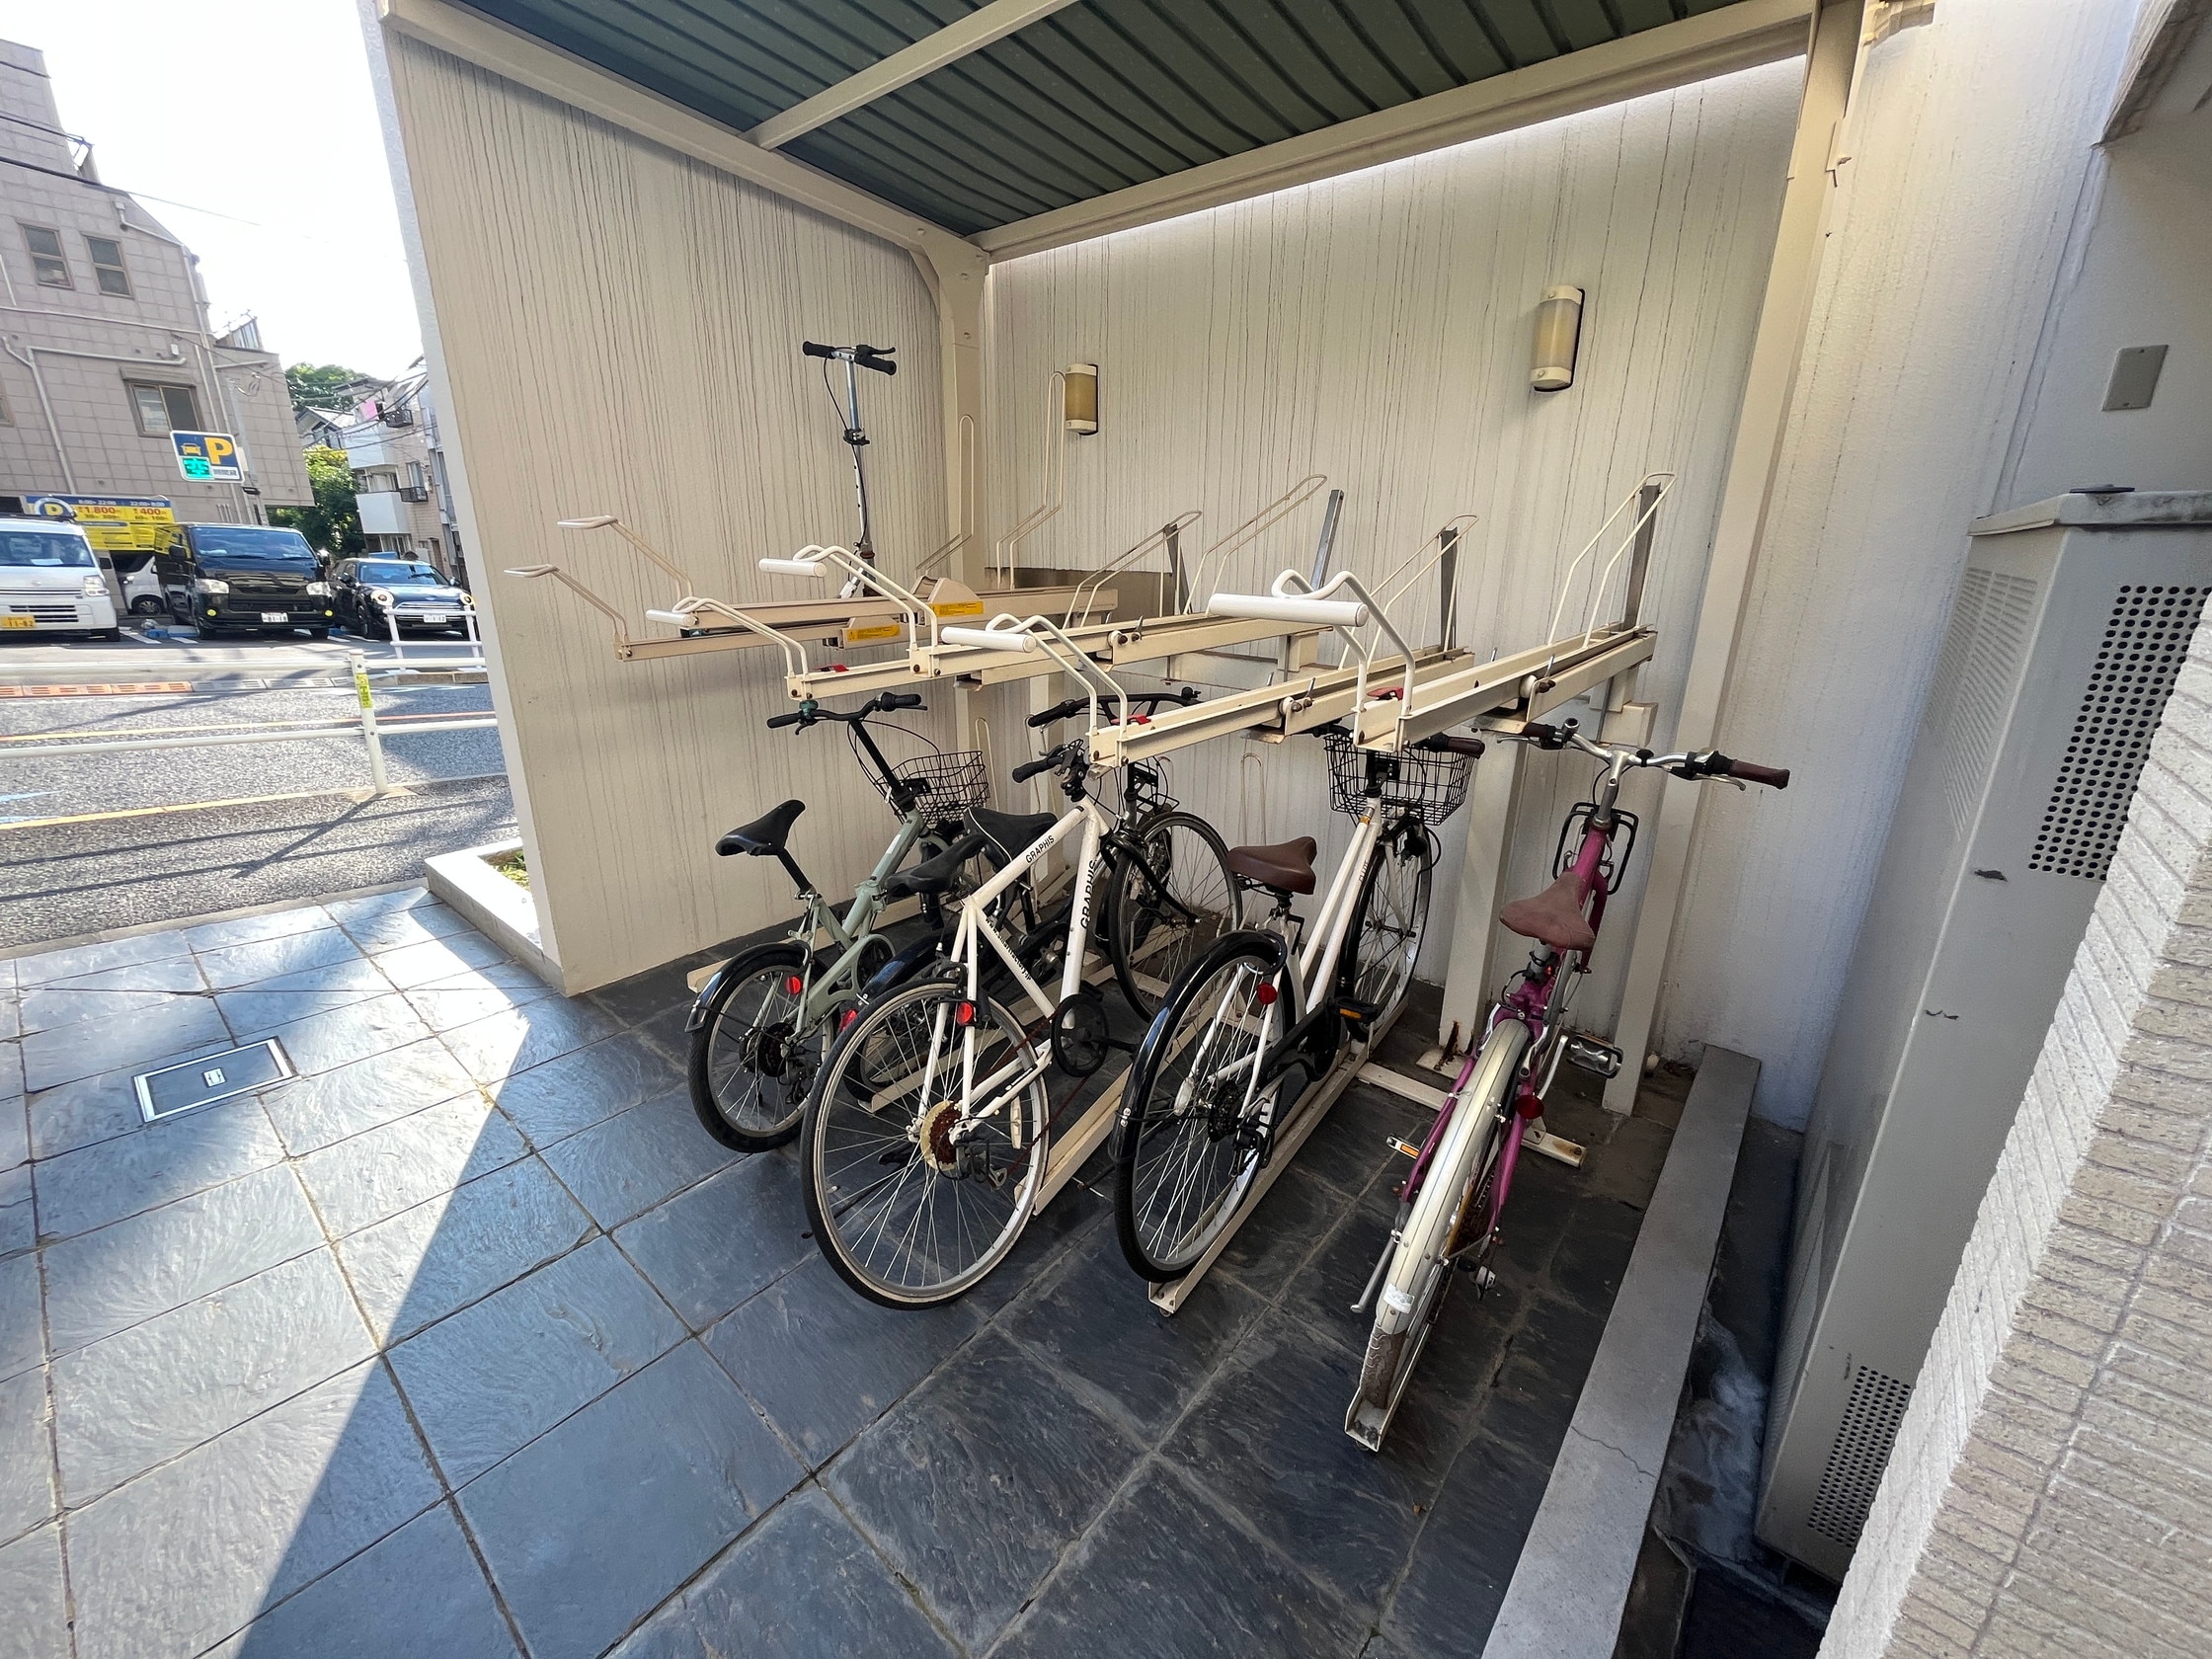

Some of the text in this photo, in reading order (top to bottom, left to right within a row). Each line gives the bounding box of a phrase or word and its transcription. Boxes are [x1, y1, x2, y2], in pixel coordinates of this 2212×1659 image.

[204, 436, 233, 464] P
[1025, 834, 1055, 863] GRAPHIS
[1080, 859, 1097, 929] GRAPHIS
